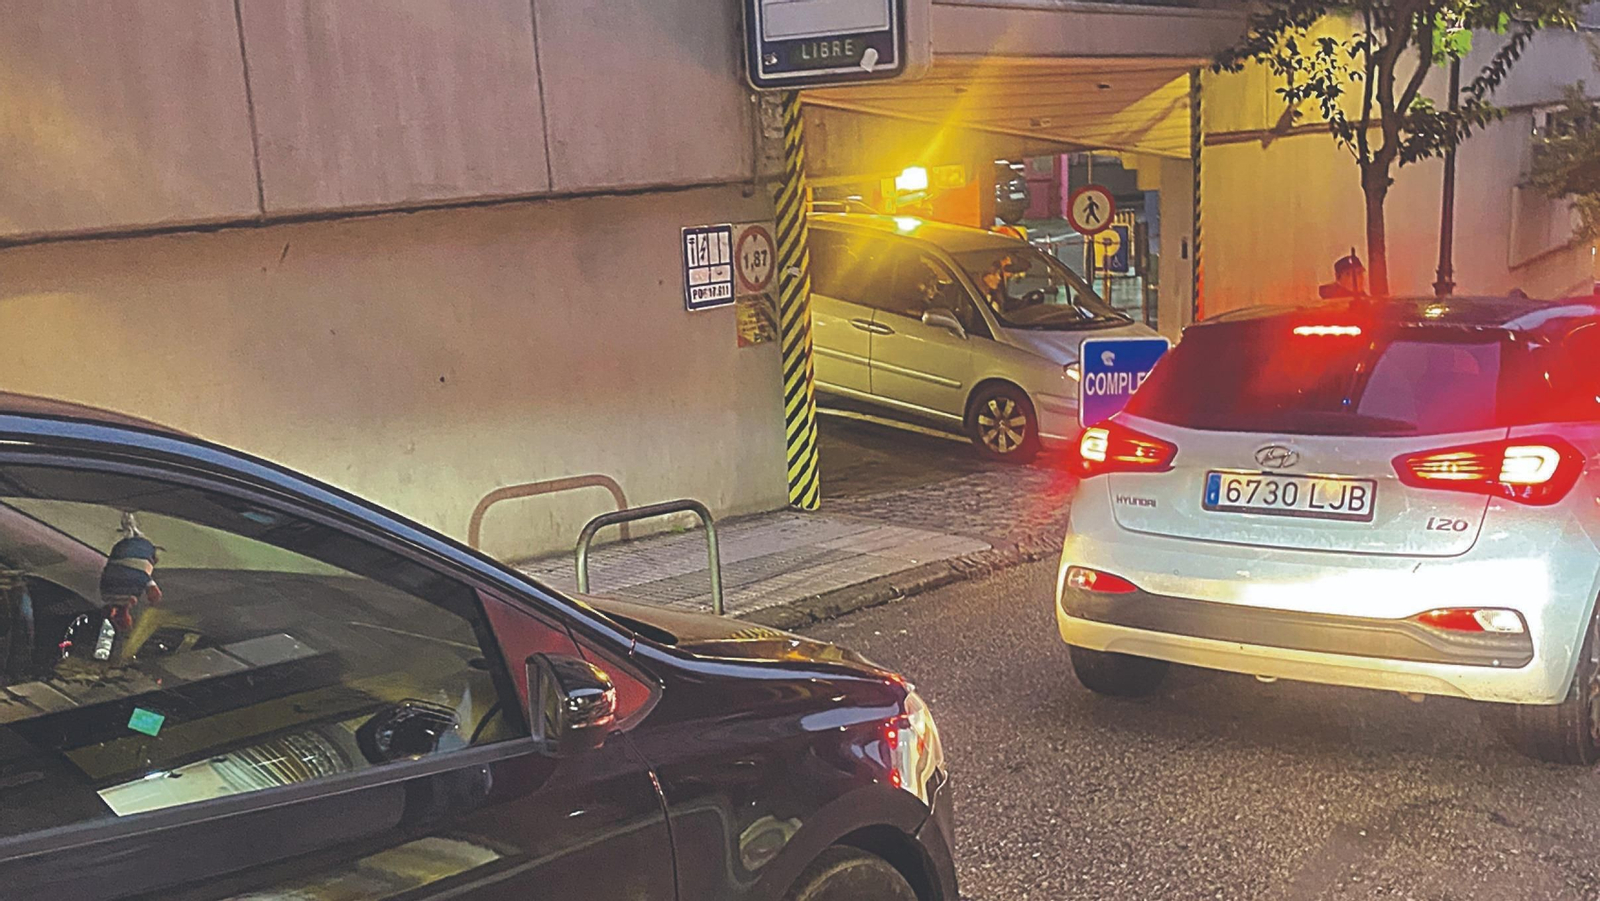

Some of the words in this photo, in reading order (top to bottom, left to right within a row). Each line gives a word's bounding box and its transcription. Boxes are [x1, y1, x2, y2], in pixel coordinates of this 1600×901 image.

[801, 40, 854, 59] LIBRE
[743, 249, 767, 271] 1,87
[1116, 494, 1157, 508] HYUNDAI
[1226, 478, 1298, 507] 6730
[1308, 483, 1367, 512] LJB
